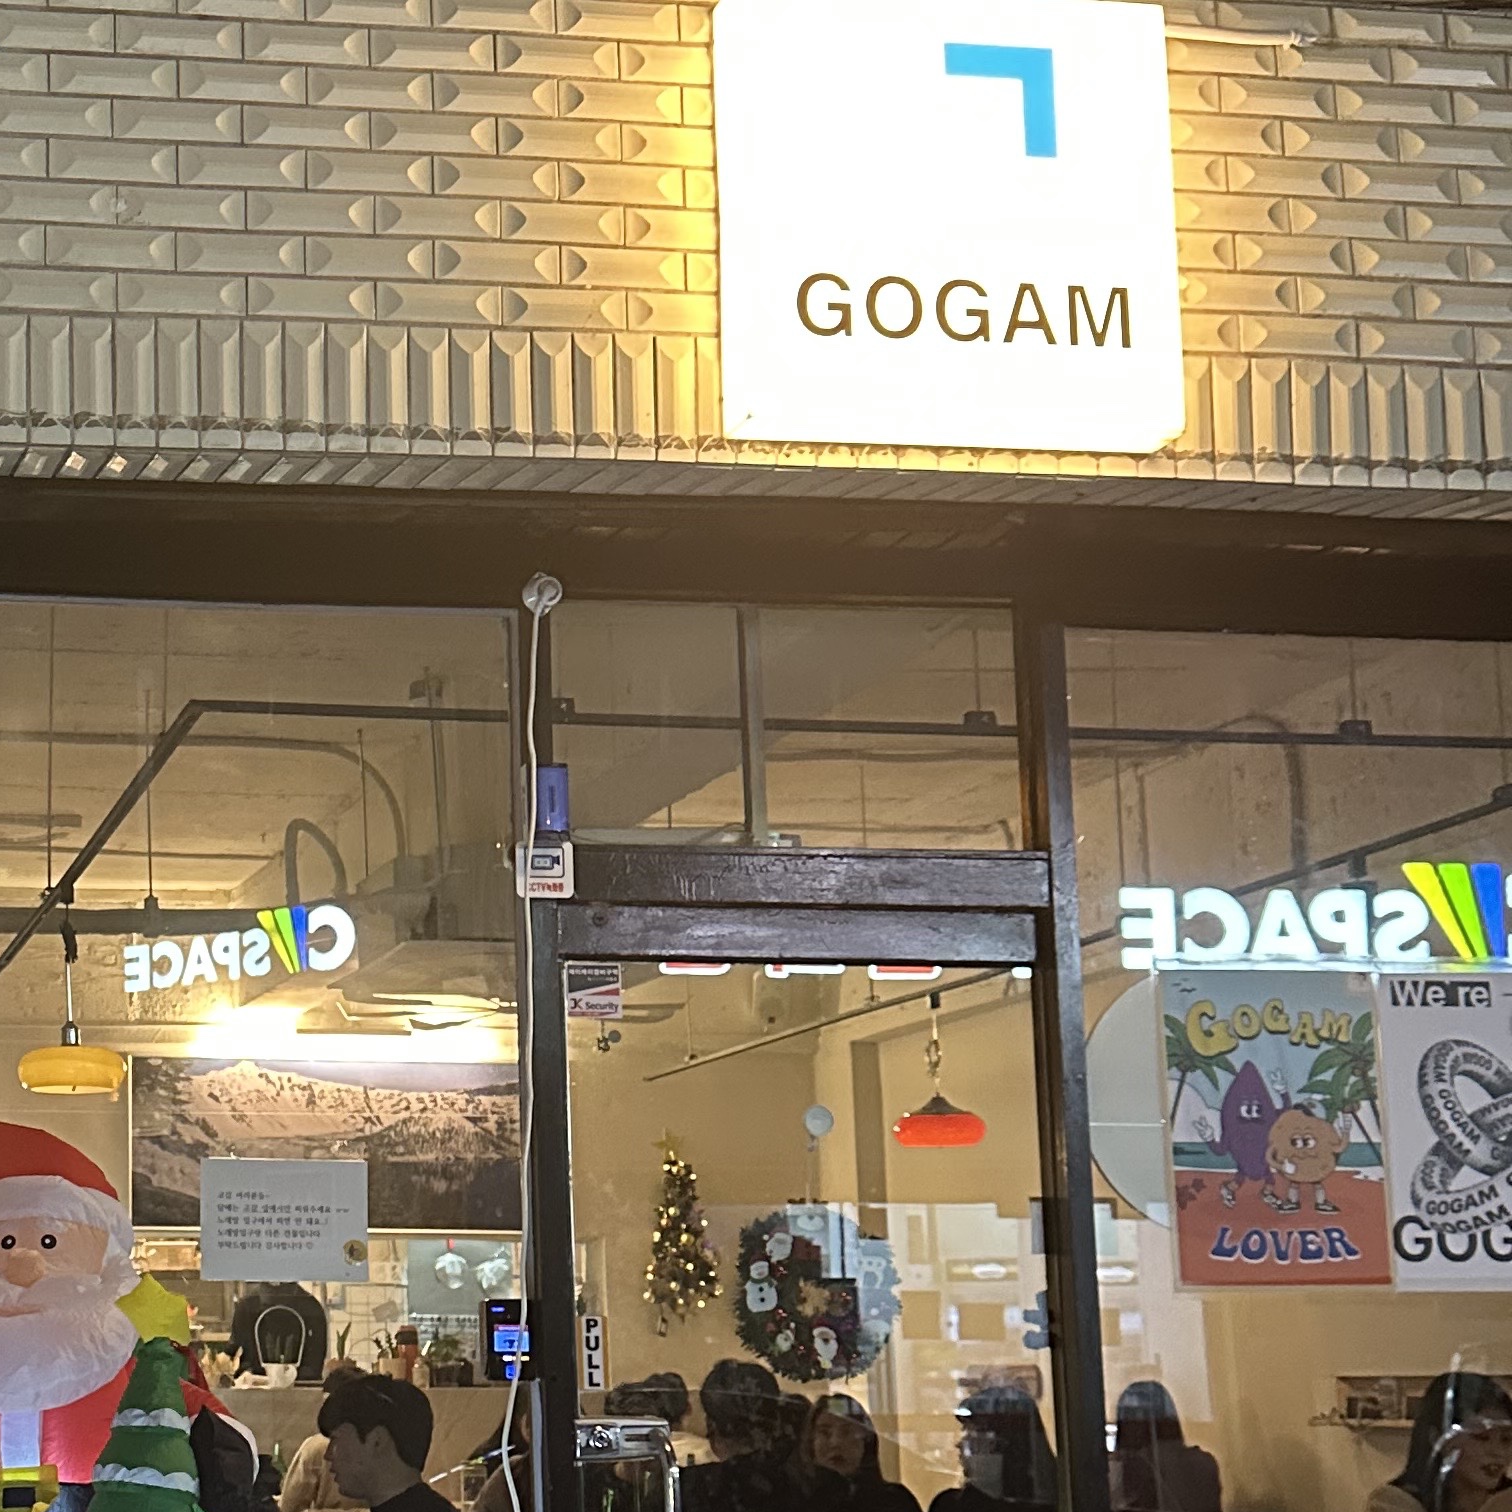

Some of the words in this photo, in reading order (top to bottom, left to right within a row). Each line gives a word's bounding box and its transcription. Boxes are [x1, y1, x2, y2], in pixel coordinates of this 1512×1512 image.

[795, 272, 1132, 349] GOGAM
[585, 1001, 619, 1012] Security
[1185, 998, 1353, 1058] GOGAM
[1426, 1183, 1500, 1216] GOGAM
[1208, 1223, 1362, 1264] LOVER
[584, 1318, 601, 1388] PULL
